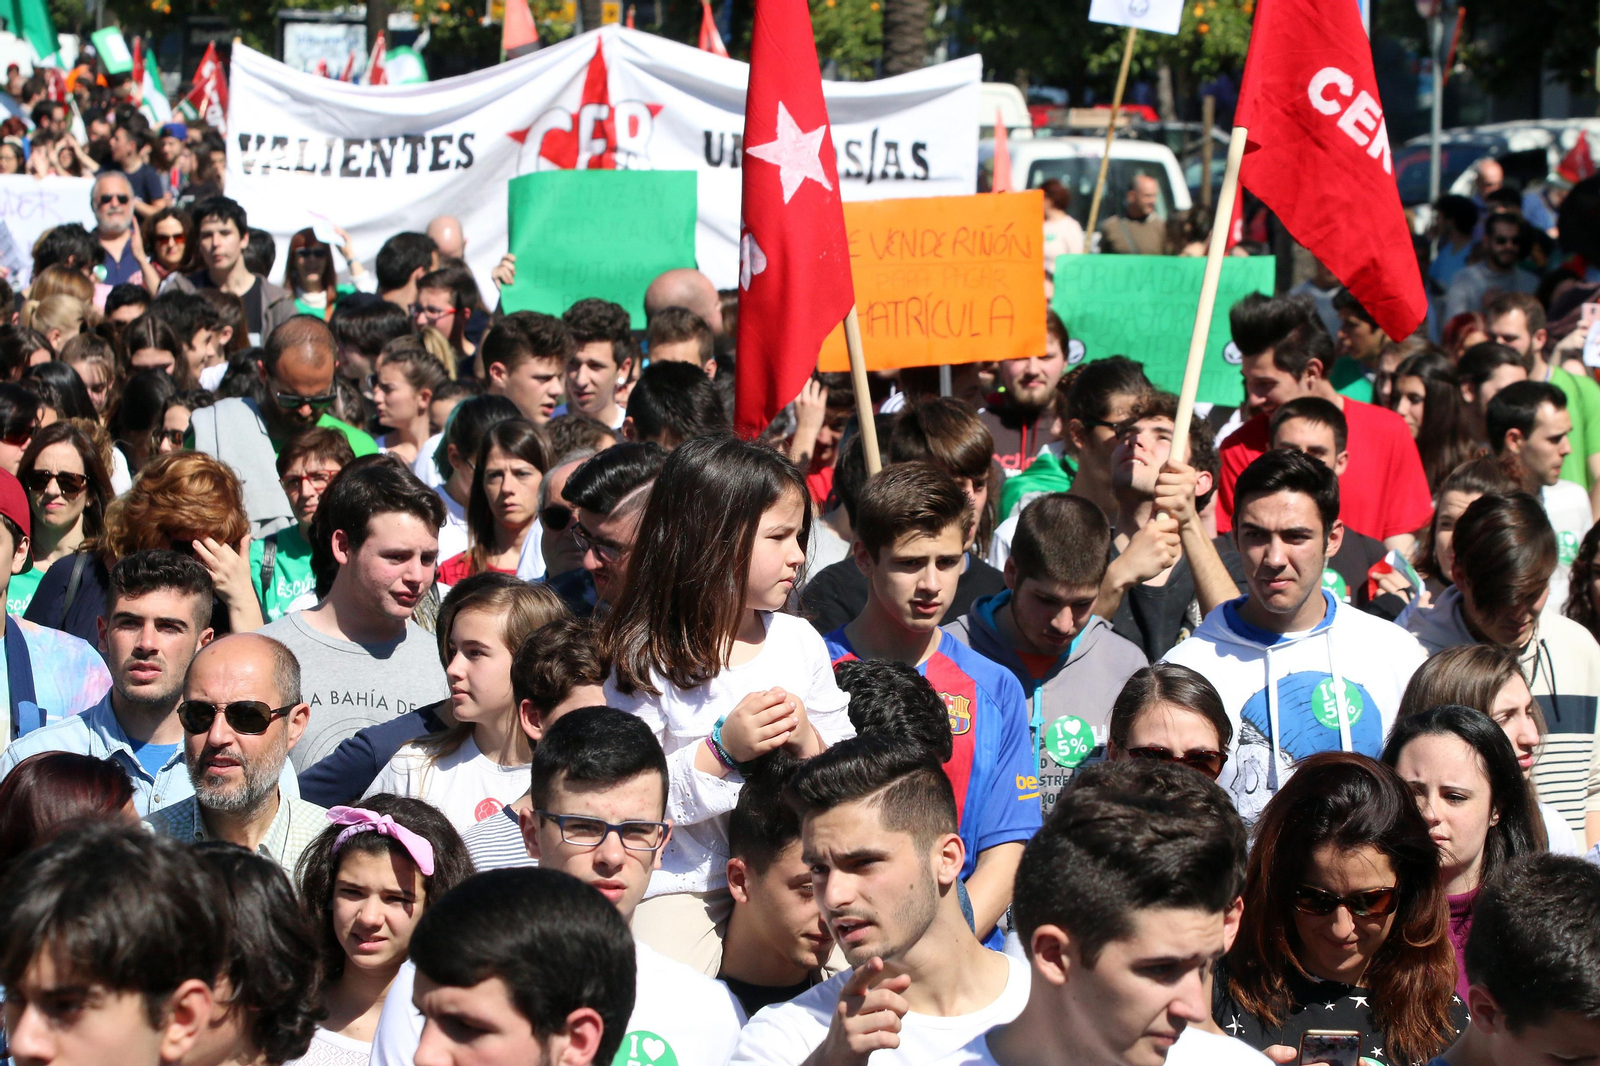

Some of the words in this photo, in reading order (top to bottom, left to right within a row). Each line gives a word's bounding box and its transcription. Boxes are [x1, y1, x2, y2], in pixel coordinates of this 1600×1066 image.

[238, 132, 475, 178] VALIENTES
[845, 228, 861, 258] E
[869, 226, 947, 260] VENDE
[952, 221, 1033, 259] RIÑÓN
[330, 689, 388, 711] BAHÍA
[1319, 683, 1330, 700] I
[1055, 722, 1064, 739] I
[1057, 736, 1088, 757] 5%
[629, 1034, 638, 1059] I
